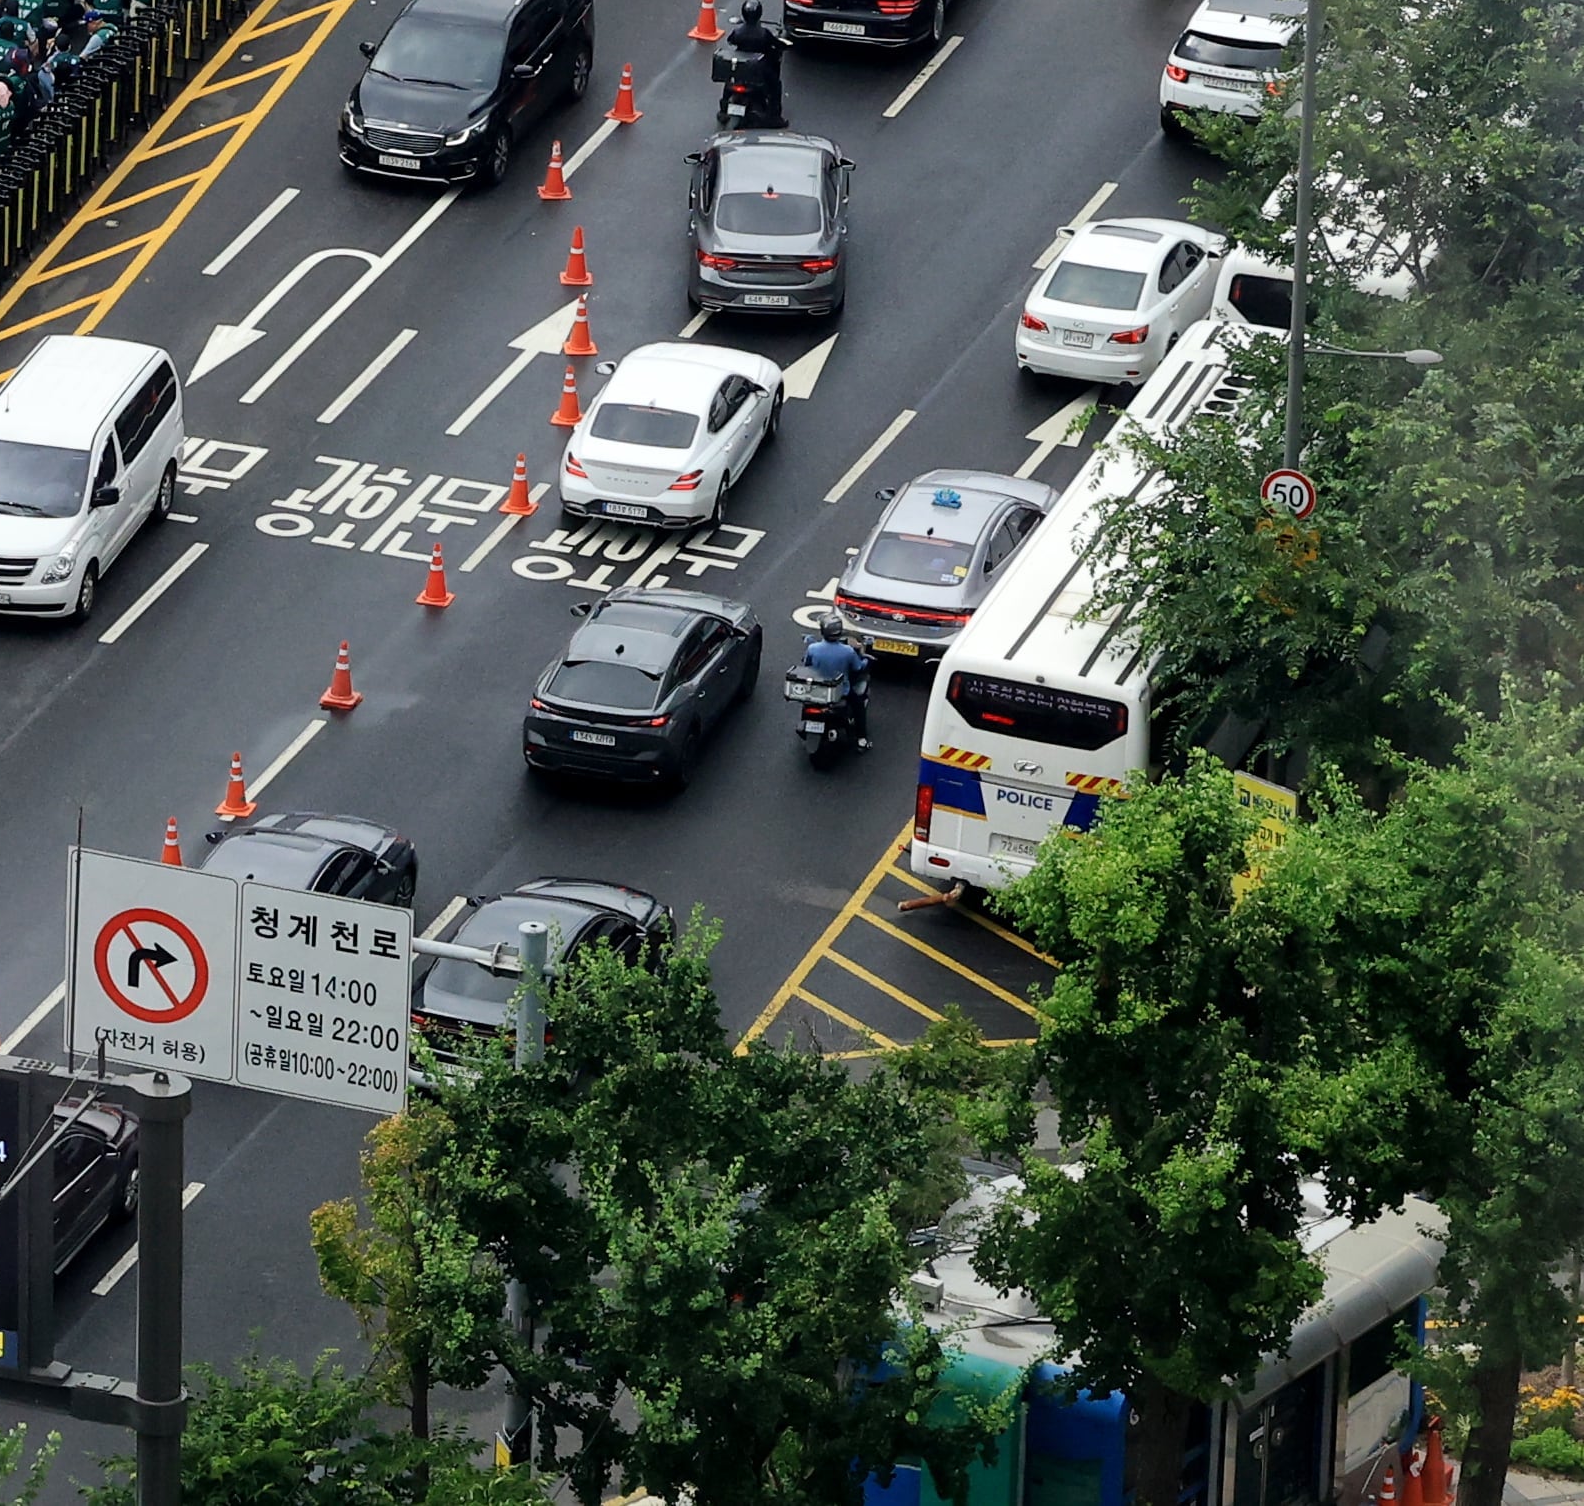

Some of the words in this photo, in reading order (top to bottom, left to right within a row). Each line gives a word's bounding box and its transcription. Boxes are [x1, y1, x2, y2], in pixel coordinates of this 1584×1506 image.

[1272, 483, 1304, 508] 50
[997, 789, 1053, 811] POLICE
[250, 905, 401, 960] 청계천로
[246, 961, 305, 994] 토요일
[311, 974, 377, 1007] 14:00
[331, 1016, 400, 1053] 22:00
[161, 1037, 206, 1065] 허용)
